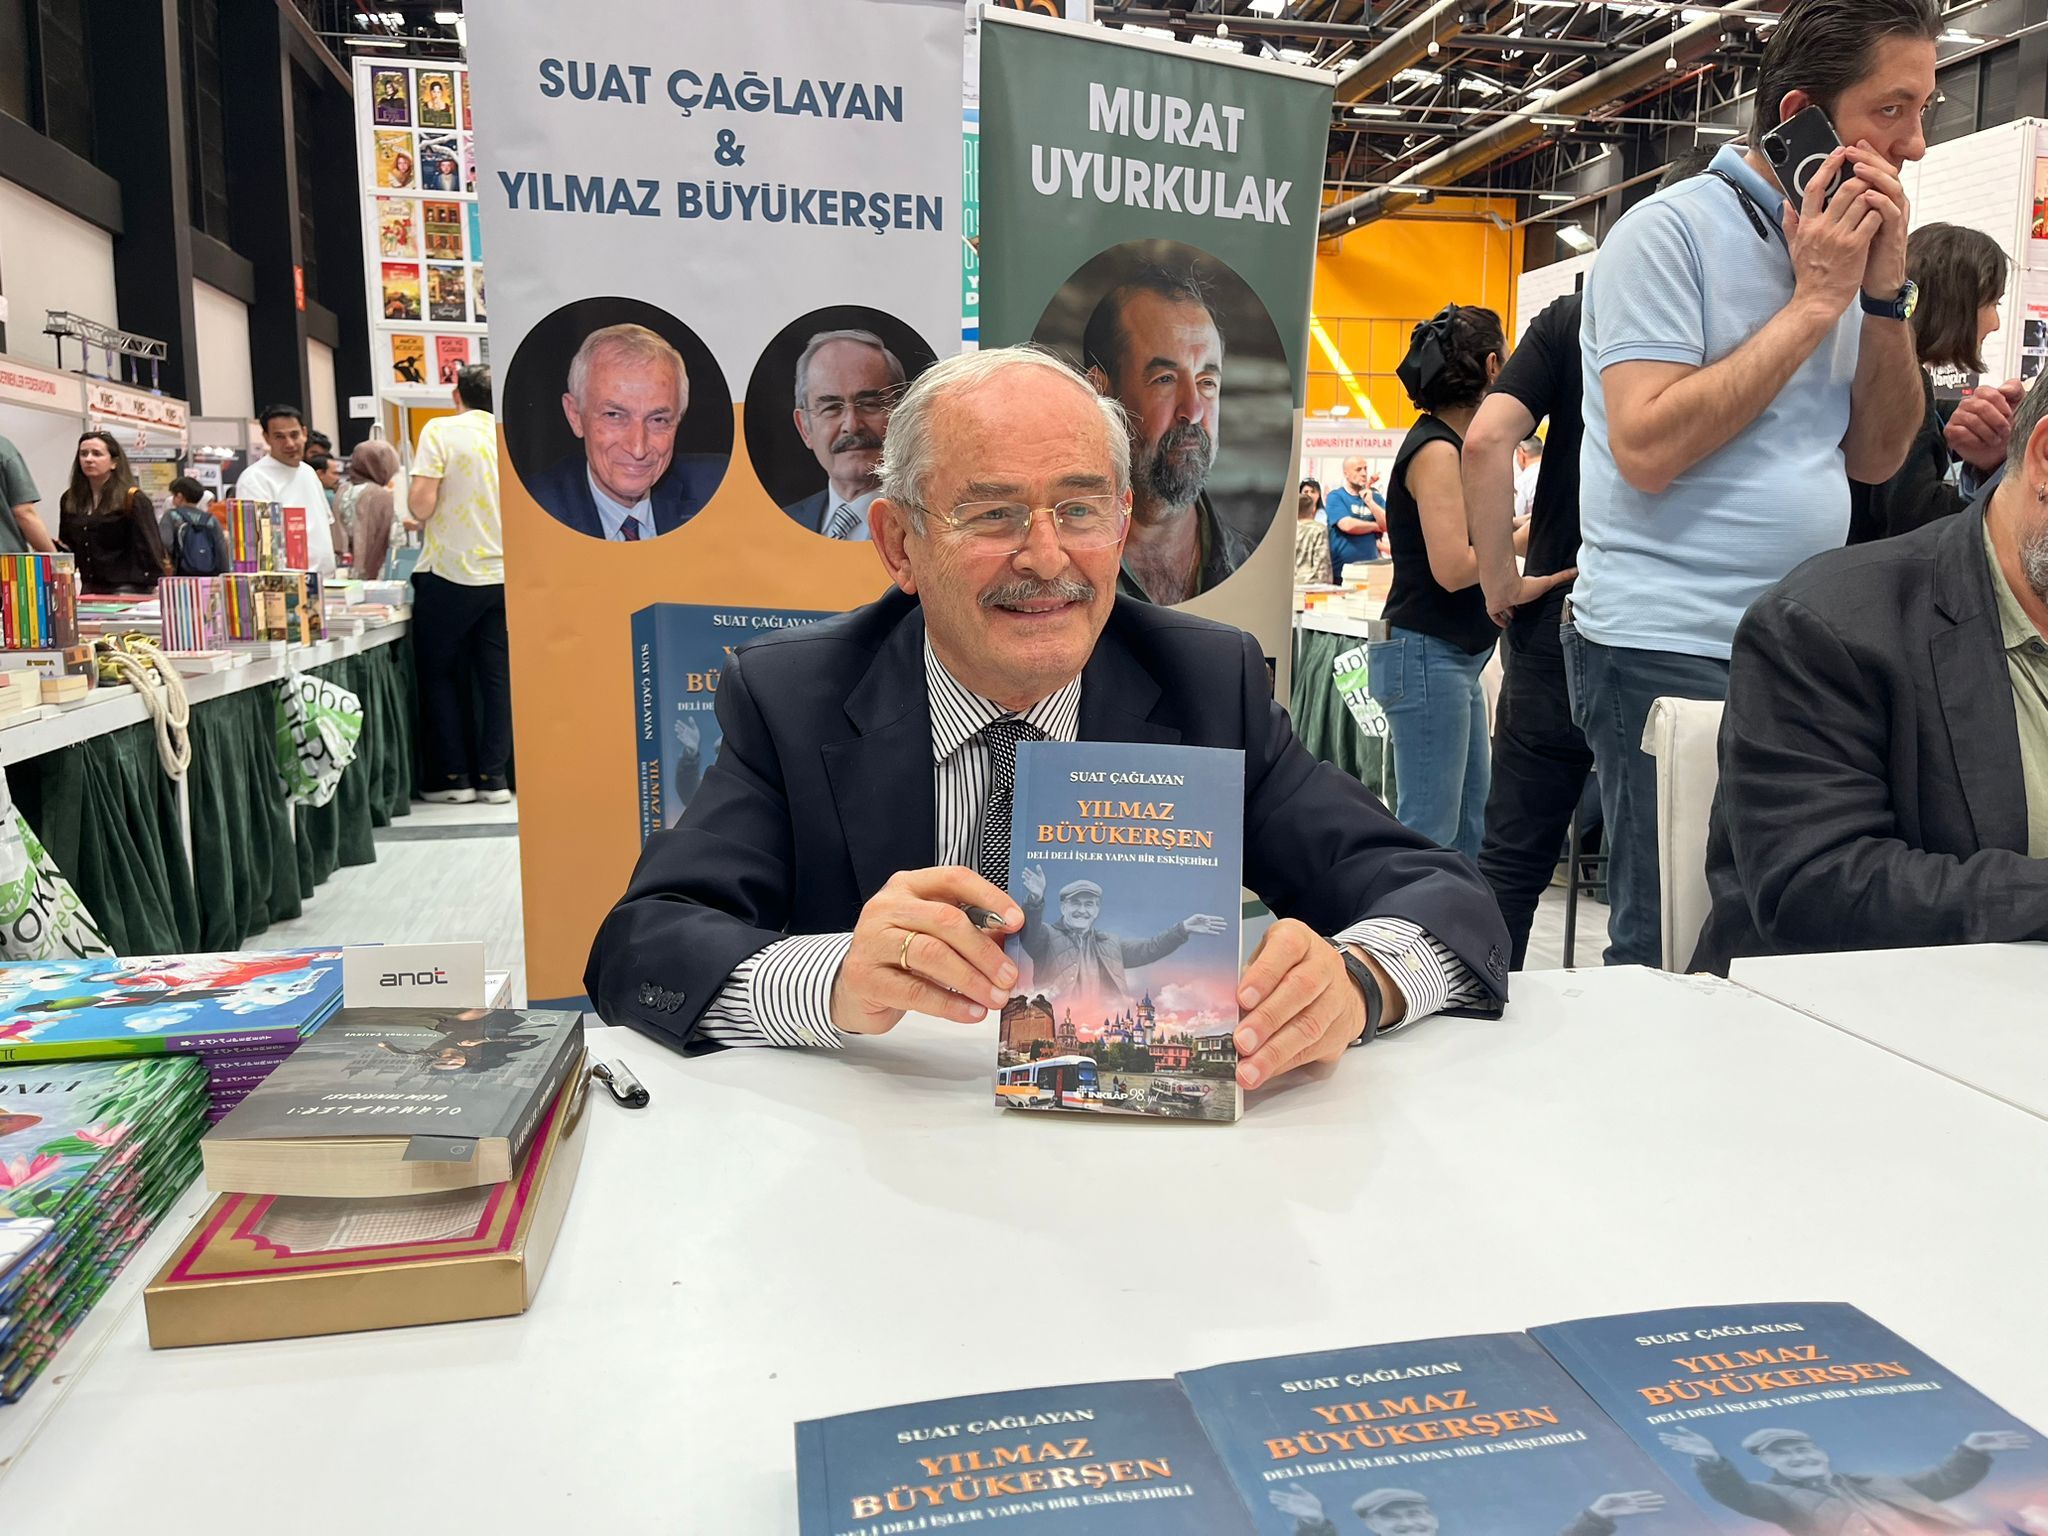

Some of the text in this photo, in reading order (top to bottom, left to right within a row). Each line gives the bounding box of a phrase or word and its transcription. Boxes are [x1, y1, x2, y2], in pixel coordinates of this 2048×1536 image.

[538, 57, 904, 123] SUAT ÇAĞLAYAN
[1088, 82, 1245, 154] MURAT
[714, 128, 746, 168] &
[496, 171, 944, 236] YILMAZ BÜYÜKERŞEN
[1031, 144, 1293, 226] UYURKULAK
[714, 614, 748, 628] SUAT
[641, 643, 653, 740] SUAT ÇAĞLAYAN
[678, 700, 714, 710] DELİ DE
[650, 759, 662, 814] YILMAZ
[1070, 770, 1185, 786] SUAT ÇAĞLAYAN
[1078, 800, 1174, 822] YILMAZ
[1037, 821, 1214, 852] BÜYÜKERŞEN
[1026, 850, 1218, 867] DELİ DELİ İŞLER YAPAN BİR ESKİŞEHİRLİ
[380, 967, 448, 986] anot
[1635, 1322, 1805, 1346] SUAT ÇAĞLAYAN
[1280, 1361, 1462, 1394] SUAT ÇAĞLAYAN
[1672, 1344, 1830, 1375] YILMAZ
[1637, 1360, 1913, 1406] BÜYÜKERŞEN
[1646, 1380, 1943, 1425] DELİ DELİ İŞLER YAPAN BİR ESKİŞEHİRLİ
[897, 1408, 1095, 1444] SUAT ÇAĞLAYAN
[1311, 1388, 1478, 1426] YILMAZ
[1263, 1406, 1561, 1461] BÜYÜKERŞEN
[917, 1437, 1094, 1478] YILMAZ
[1262, 1430, 1588, 1482] DELİ DELİ İŞLER YAPAN BİR ESKİŞEHİRLİ
[850, 1457, 1173, 1519] BÜYÜKERŞEN
[883, 1516, 927, 1535] DELİ
[930, 1509, 984, 1529] İŞLER
[987, 1501, 1045, 1518] YAPAN
[1049, 1496, 1080, 1511] BİR
[1083, 1484, 1194, 1507] ESKİŞEHİRLİ
